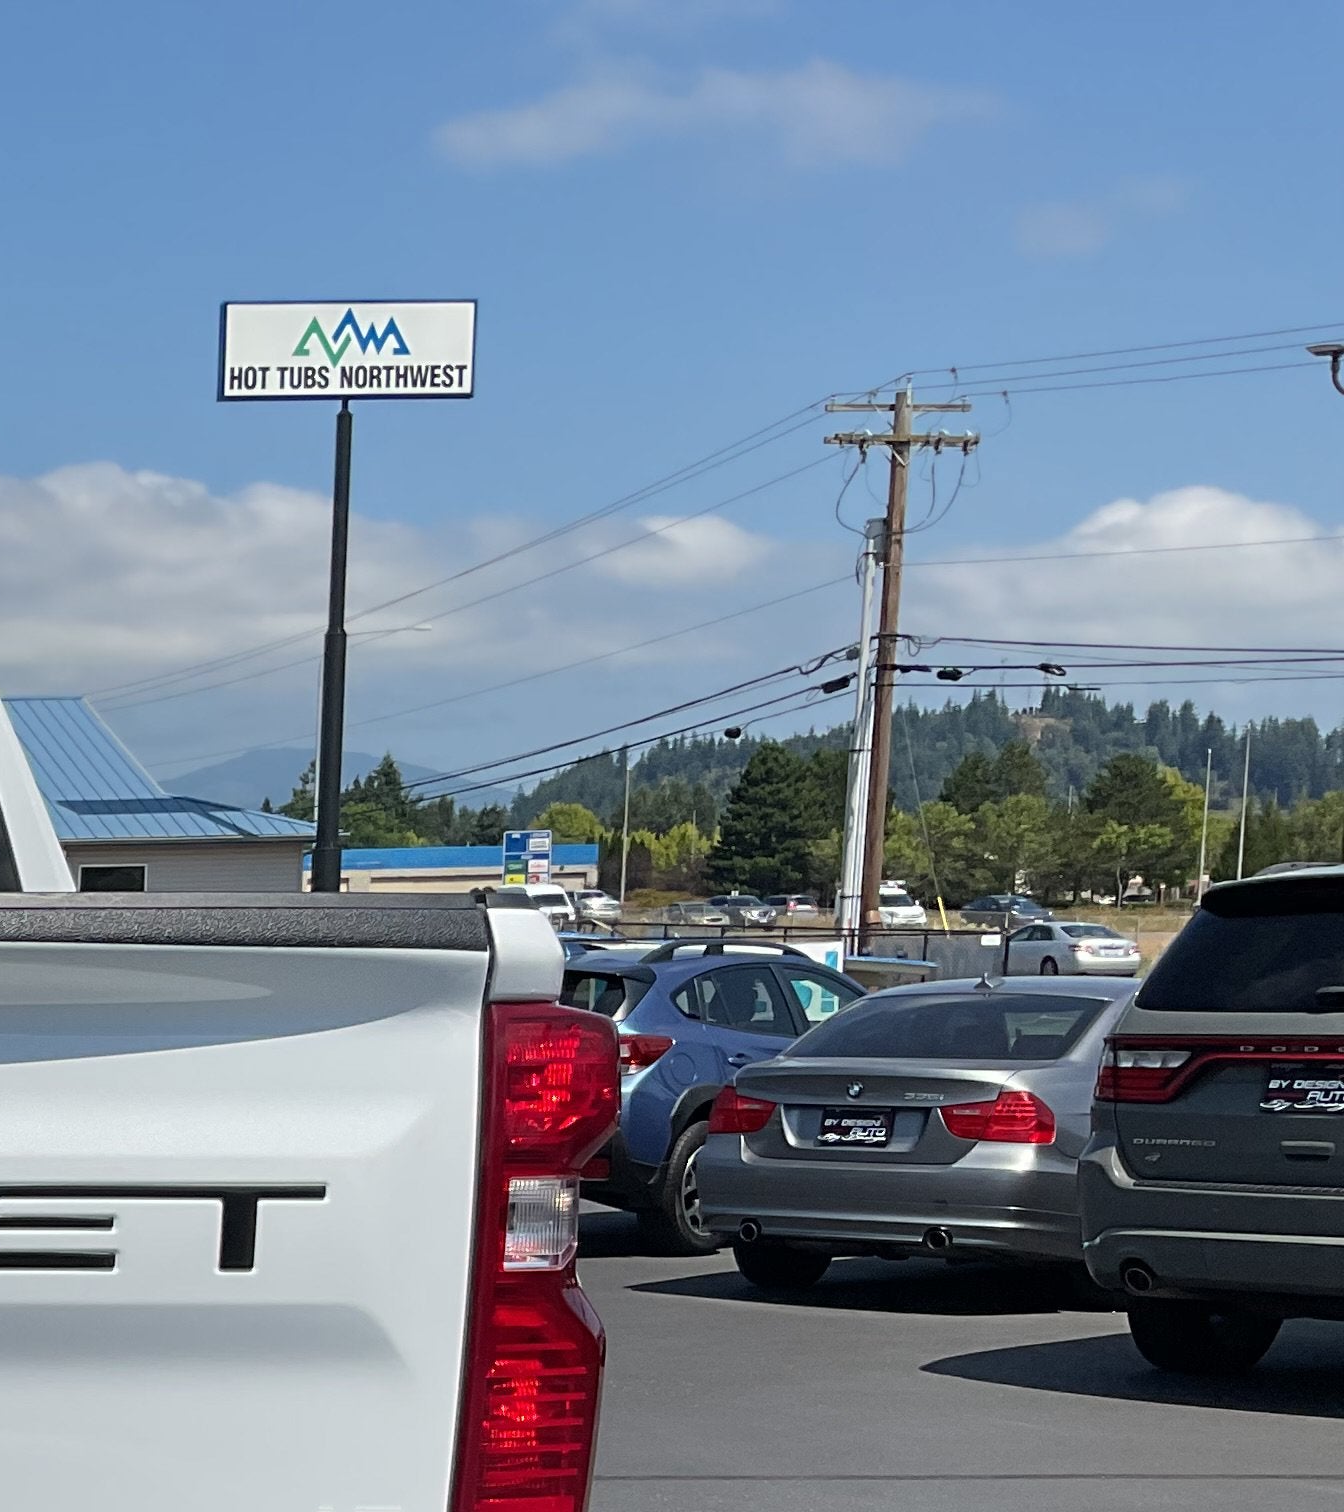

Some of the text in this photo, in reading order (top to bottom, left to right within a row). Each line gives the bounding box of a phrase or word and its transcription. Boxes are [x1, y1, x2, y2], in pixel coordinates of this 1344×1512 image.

[229, 364, 468, 390] HOT TUBS NORTHWEST
[1269, 1079, 1291, 1089] BY
[824, 1118, 882, 1127] BY DESIGN
[849, 1127, 887, 1136] AUTO
[1132, 1137, 1217, 1148] DURANGO
